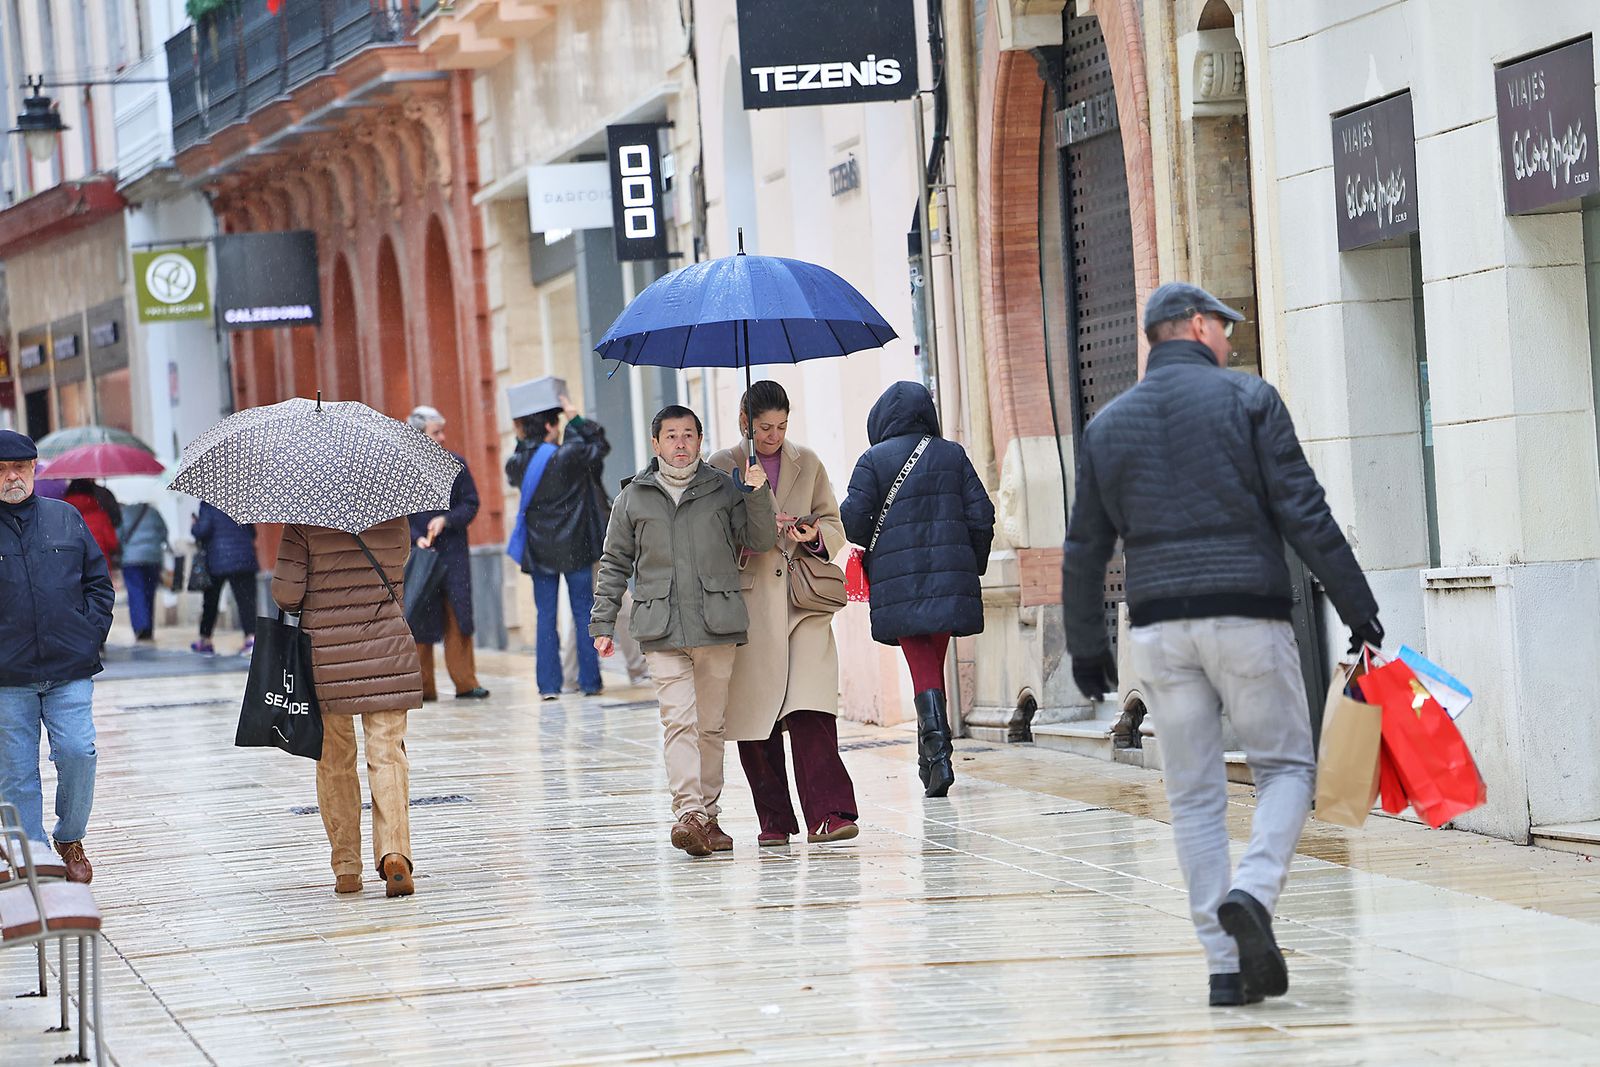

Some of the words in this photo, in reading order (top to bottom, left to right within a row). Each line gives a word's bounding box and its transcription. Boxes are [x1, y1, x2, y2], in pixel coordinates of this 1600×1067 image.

[1508, 70, 1546, 111] VIAJES
[1342, 120, 1374, 157] VIAJES
[1524, 129, 1550, 179] Corte
[264, 692, 309, 715] SEIDE
